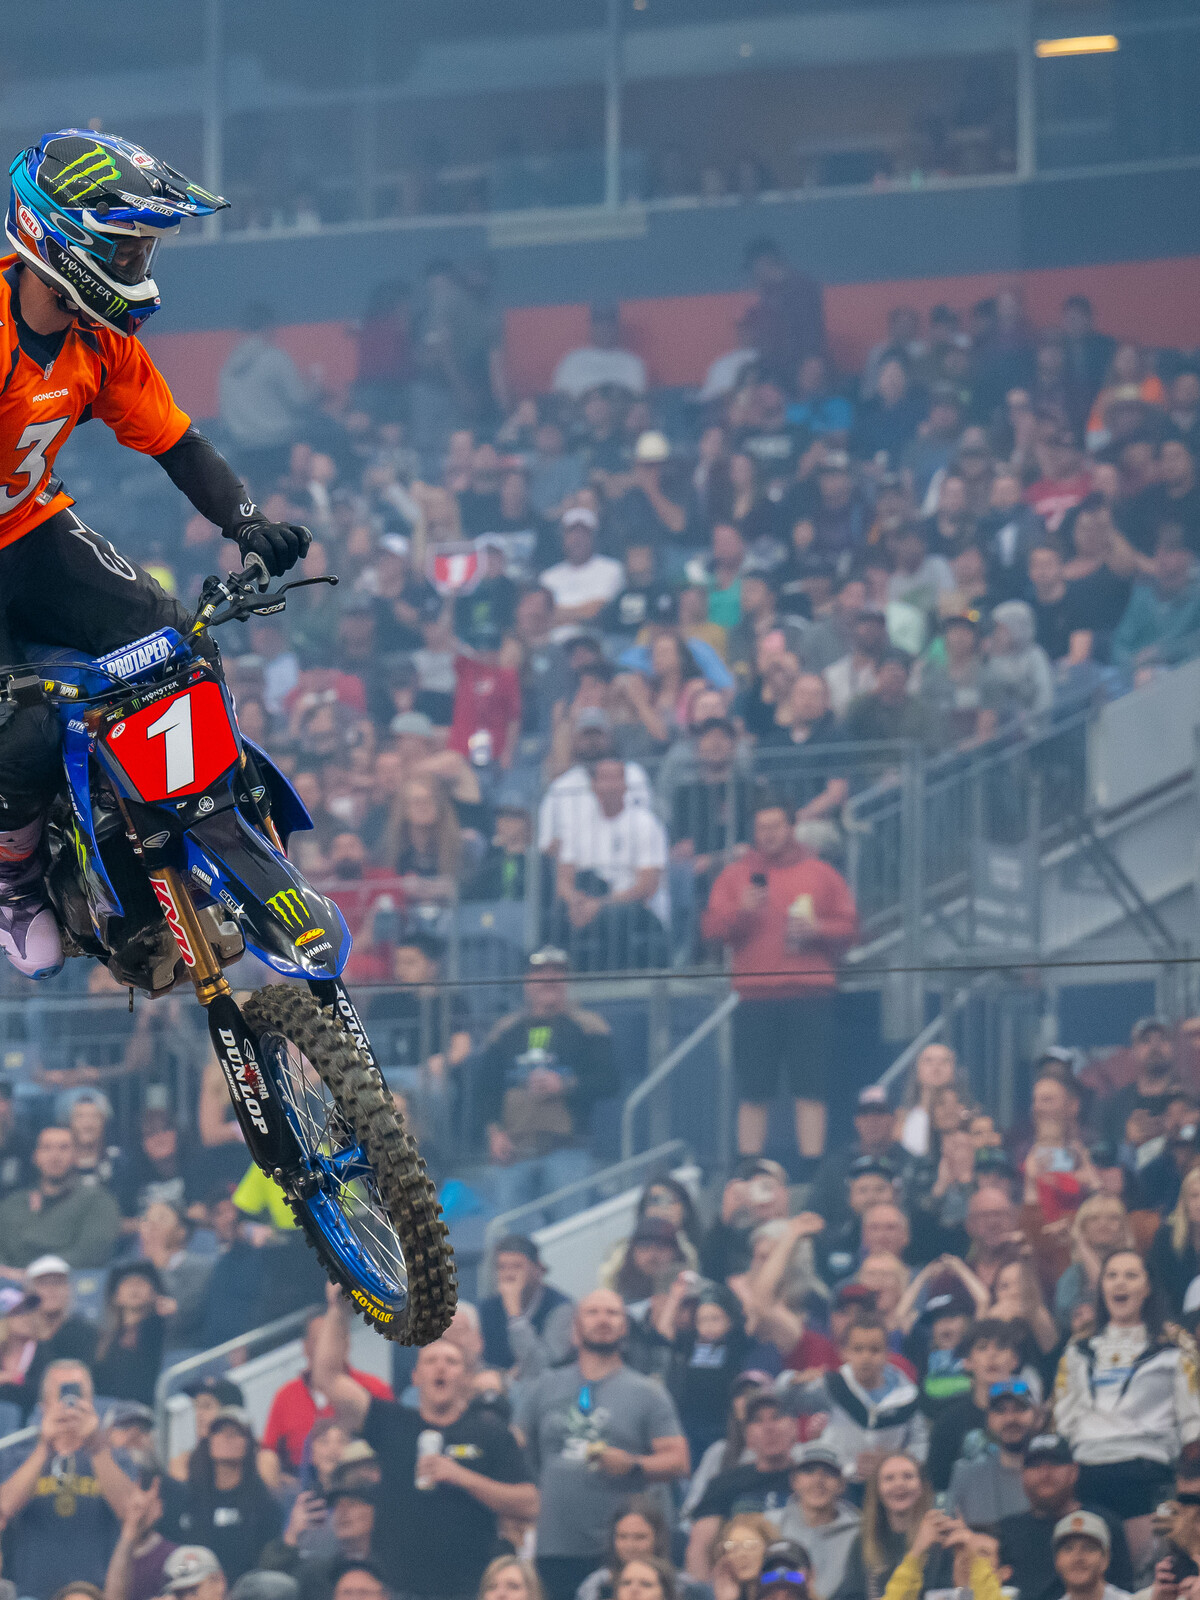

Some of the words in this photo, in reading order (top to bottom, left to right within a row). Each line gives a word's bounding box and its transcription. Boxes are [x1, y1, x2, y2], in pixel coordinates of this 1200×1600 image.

[20, 211, 39, 236] BELL
[58, 252, 112, 301] MONSTER
[60, 266, 98, 299] ENERGY
[106, 638, 169, 678] PROTAPER
[141, 681, 179, 703] MONSTER
[146, 692, 195, 795] 1
[305, 942, 333, 959] YAMAHA
[219, 1028, 269, 1135] DUNLOP
[249, 1061, 270, 1100] CYCRA
[351, 1290, 391, 1323] DUNLOP
